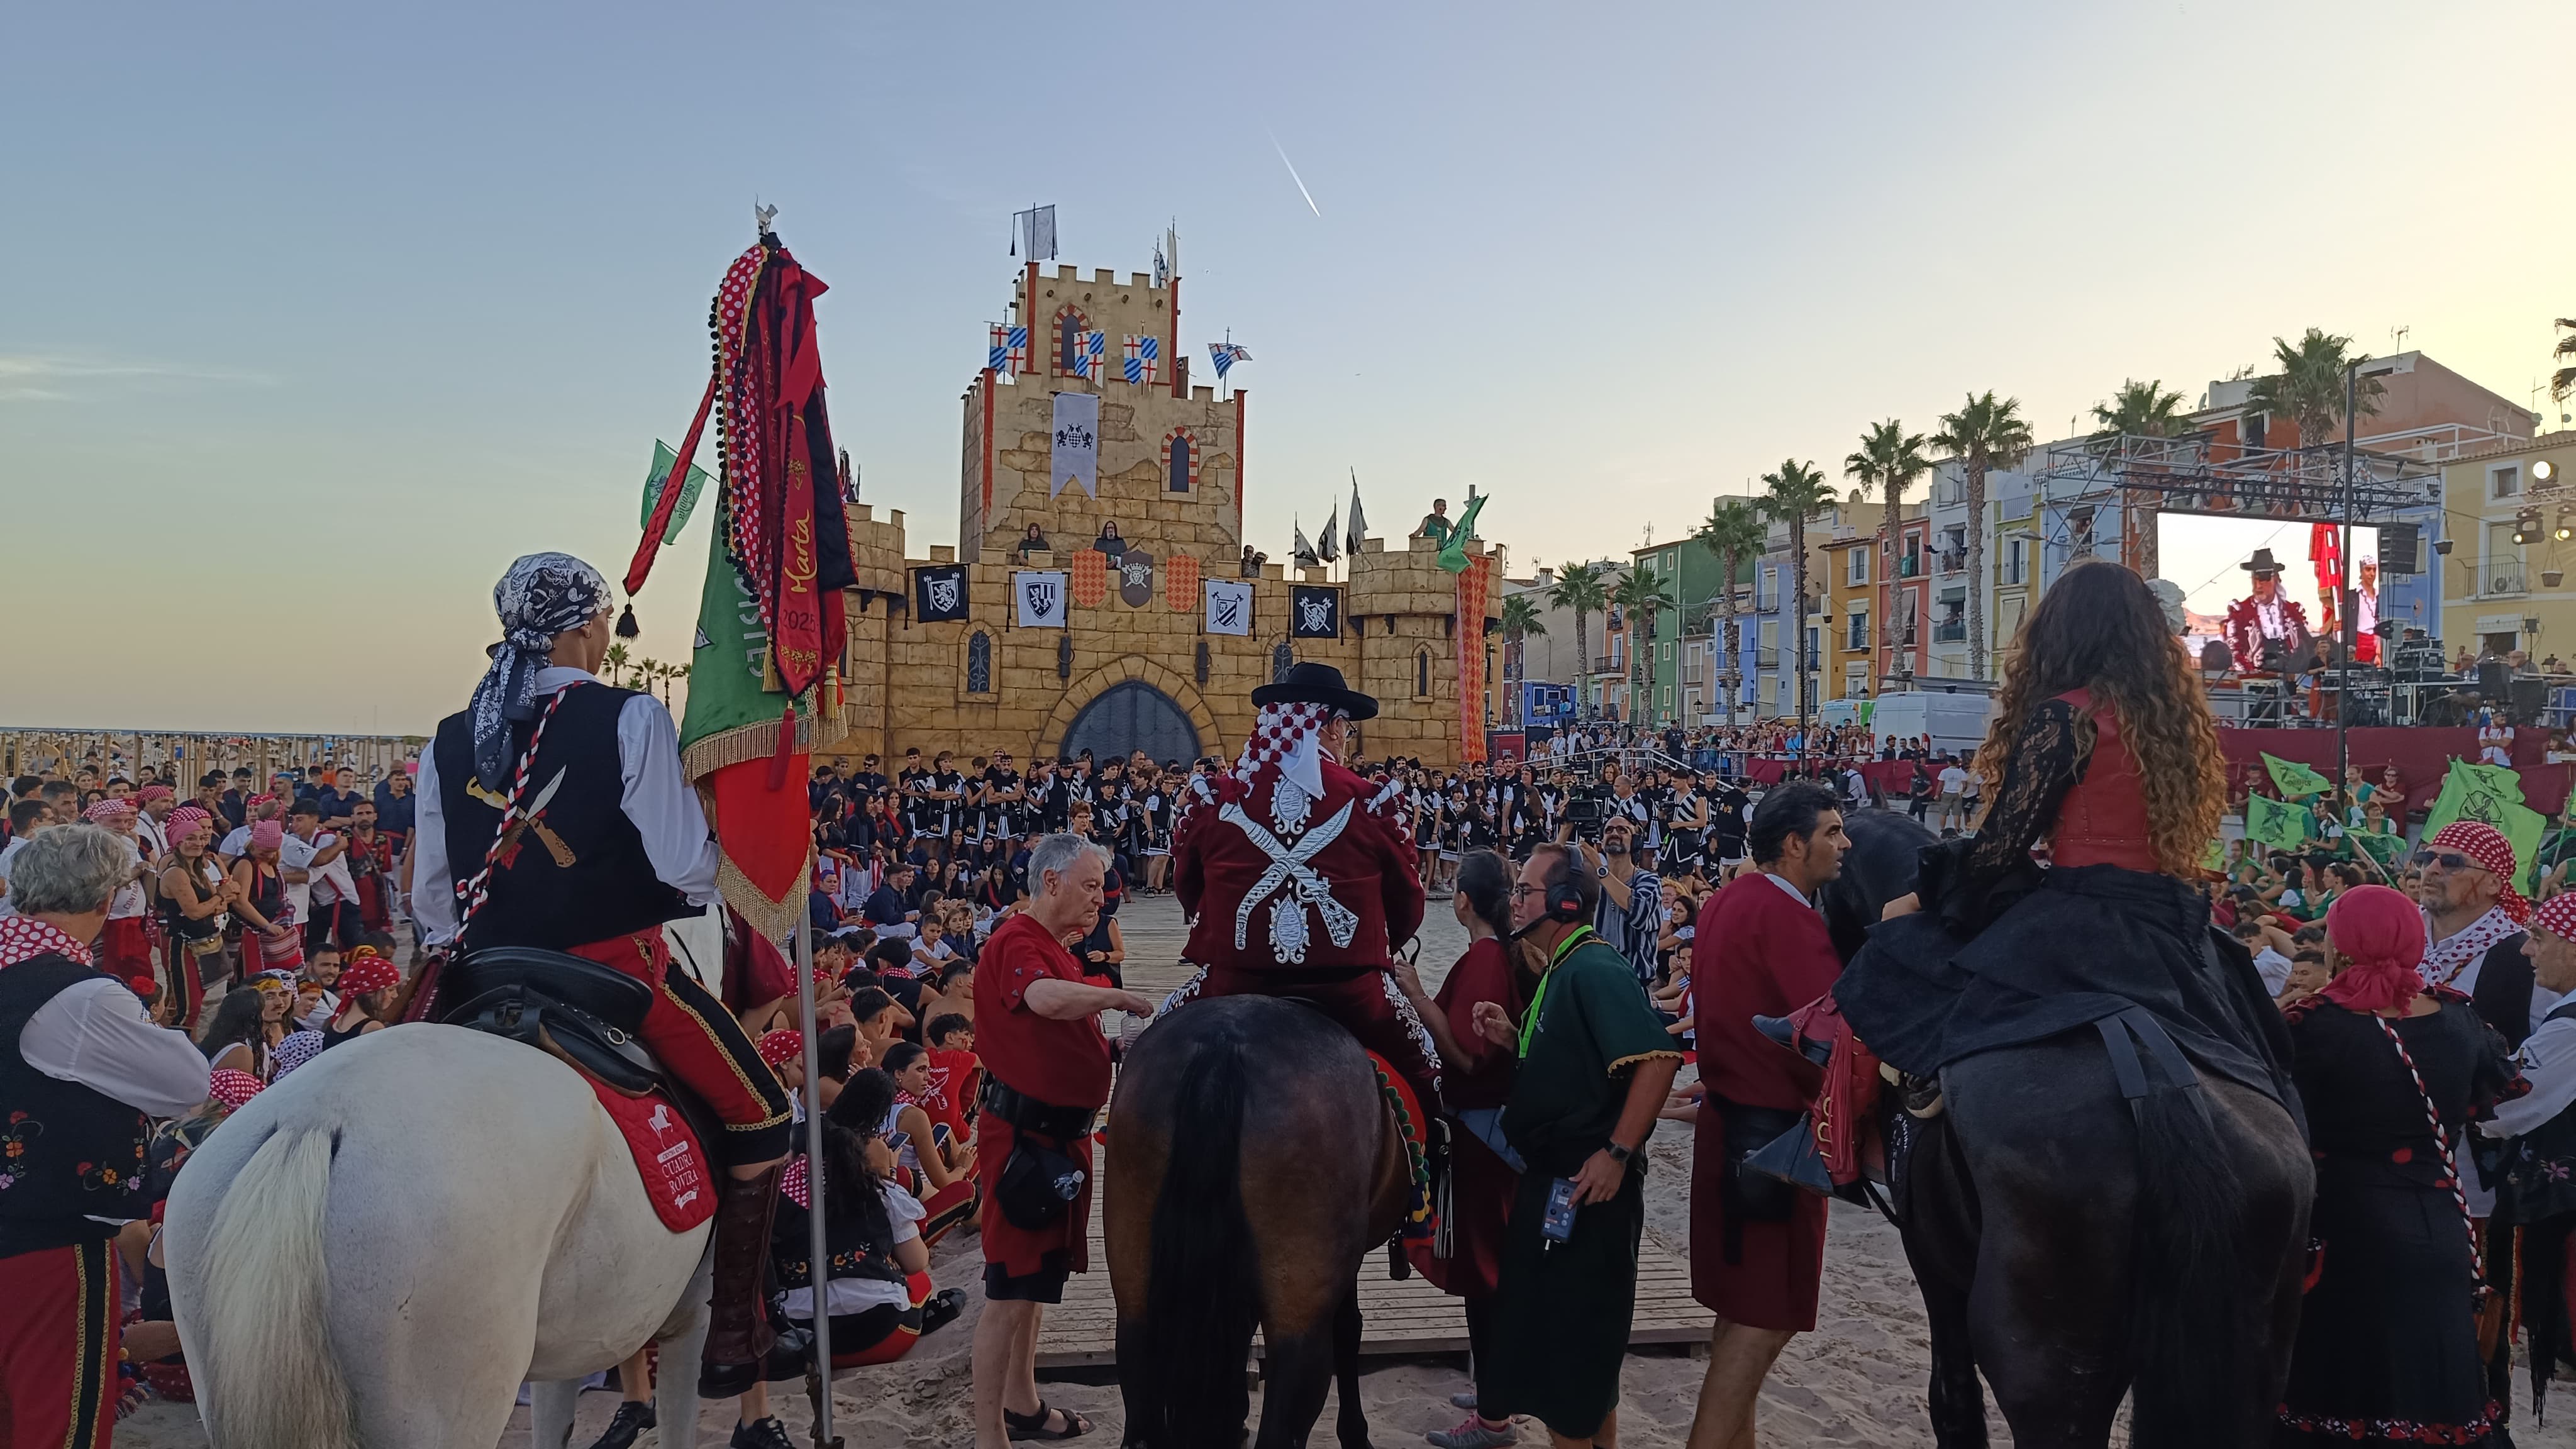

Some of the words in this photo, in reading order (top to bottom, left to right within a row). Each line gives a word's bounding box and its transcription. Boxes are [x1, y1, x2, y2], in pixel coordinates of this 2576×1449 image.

[784, 508, 818, 593] Marta
[783, 609, 816, 633] 2025
[662, 1153, 694, 1177] CUADRA
[669, 1169, 699, 1194] ROVIRA
